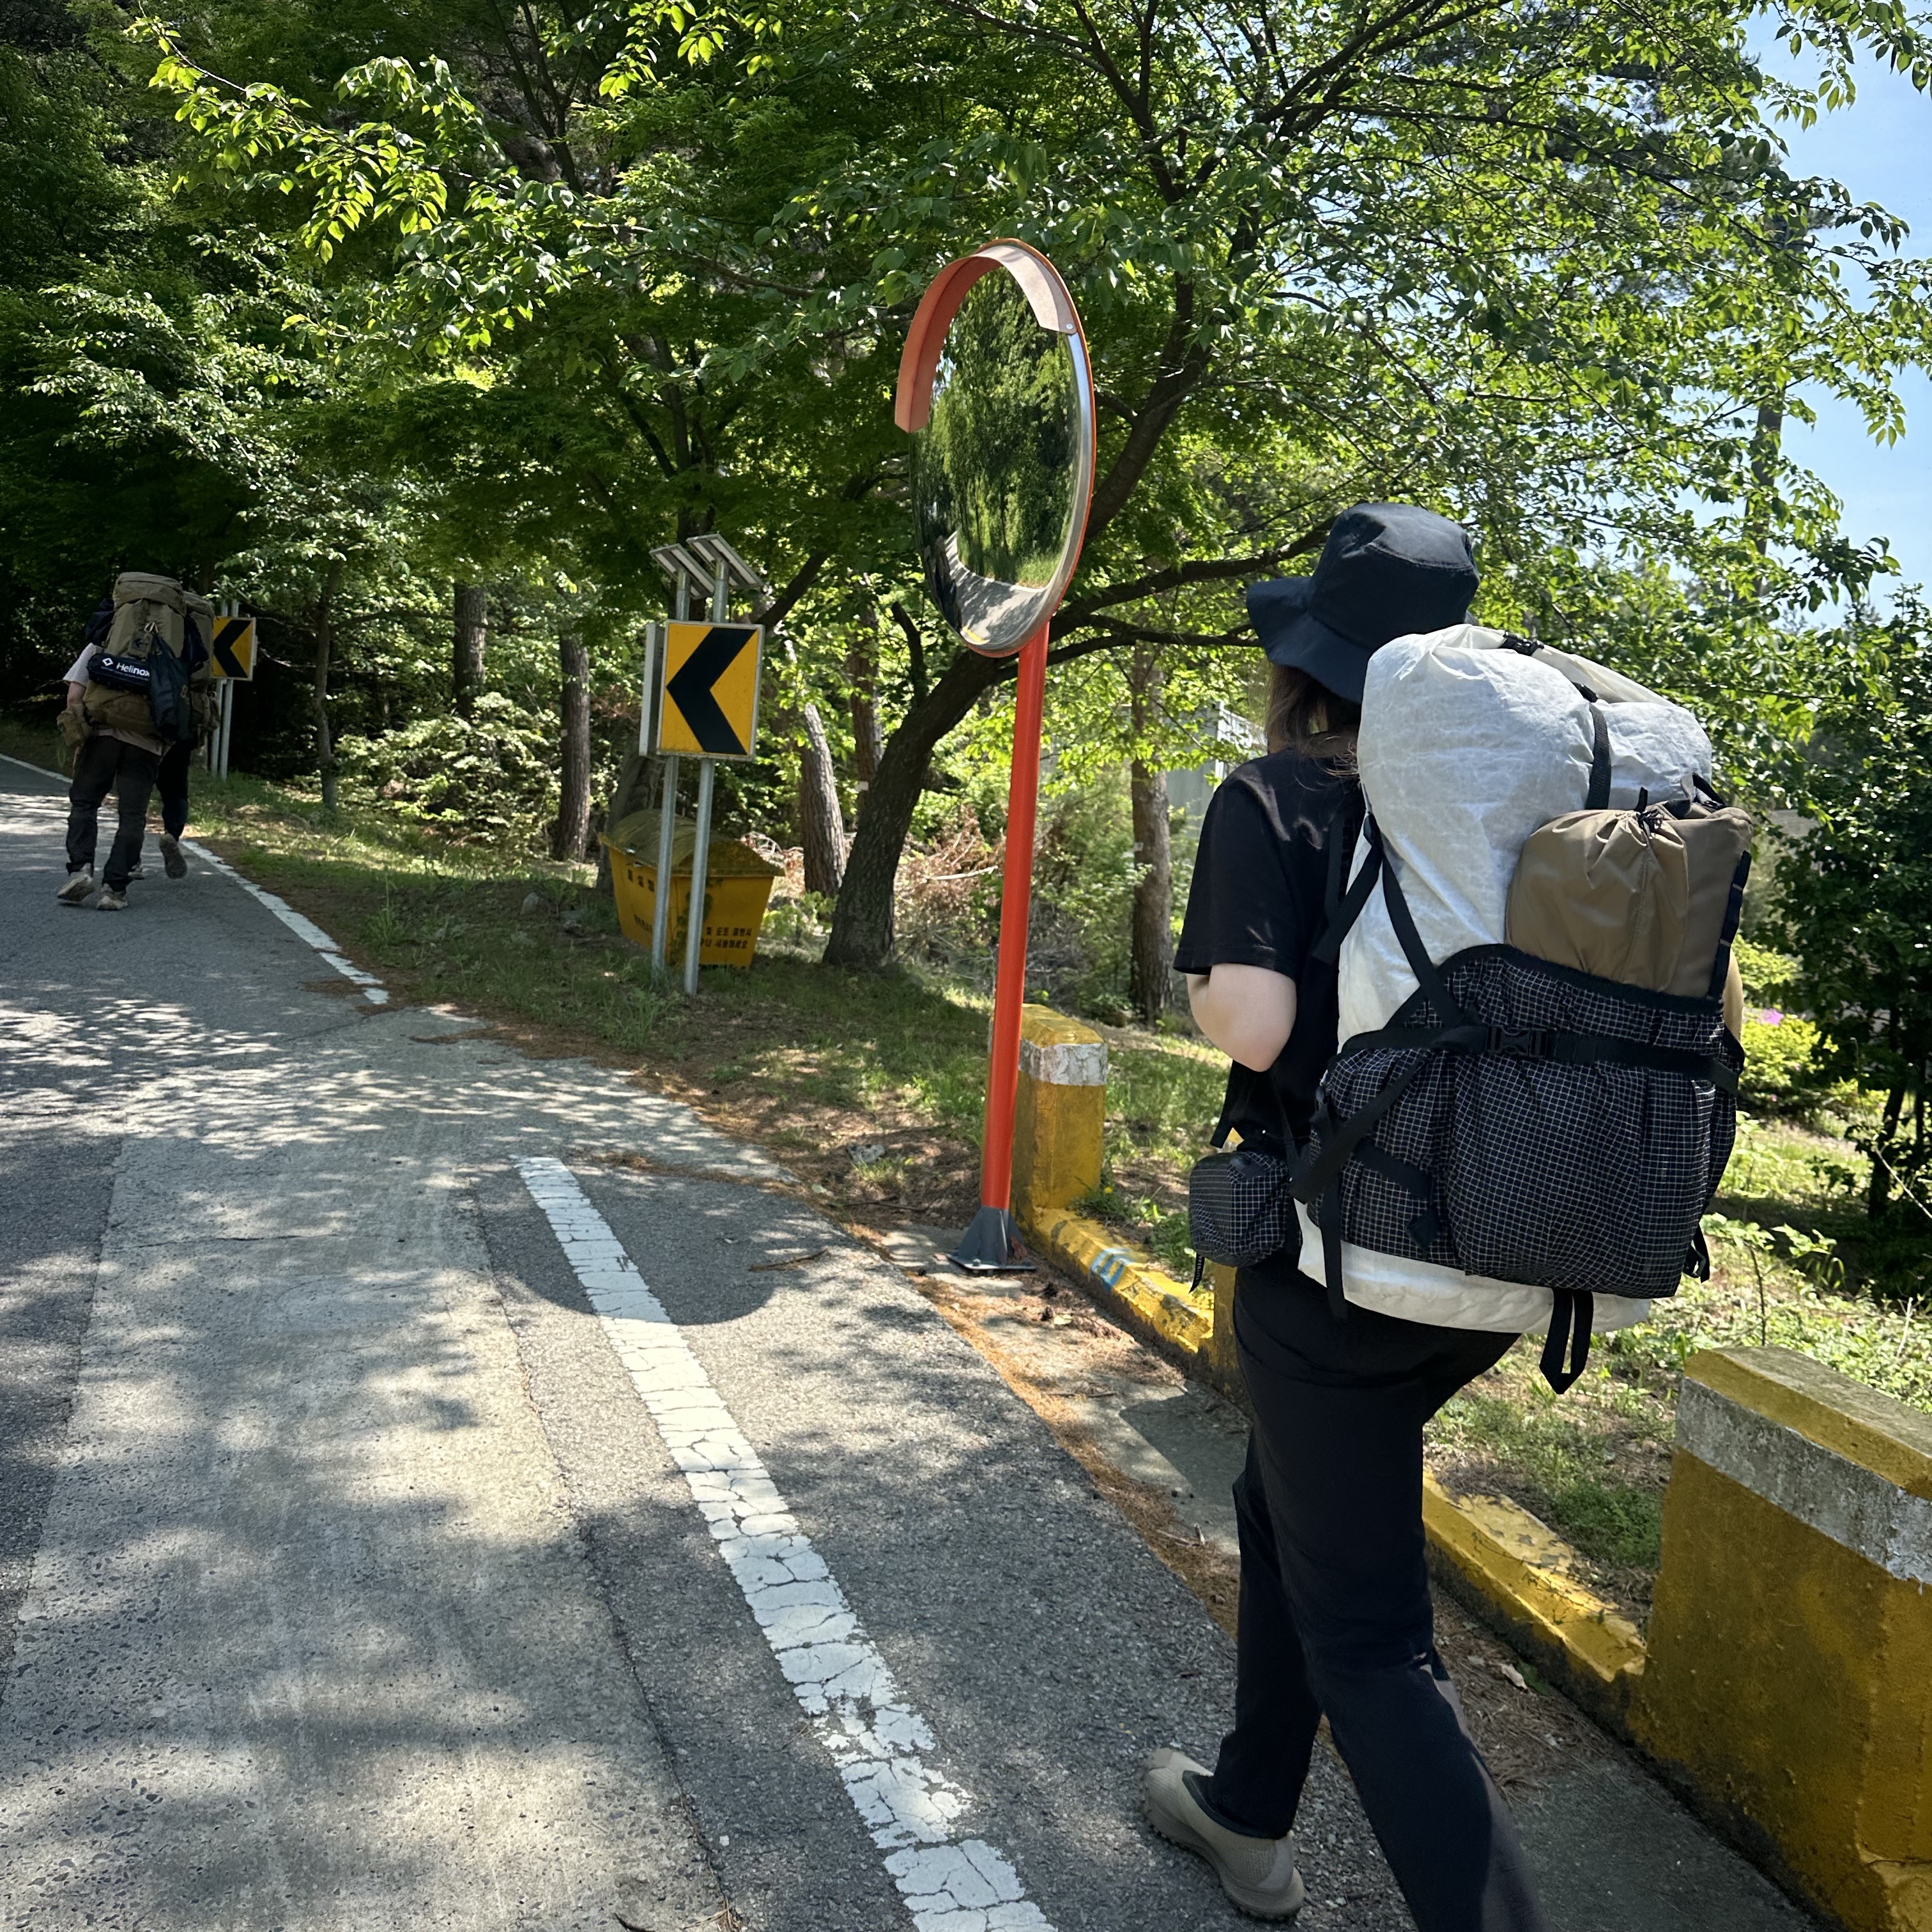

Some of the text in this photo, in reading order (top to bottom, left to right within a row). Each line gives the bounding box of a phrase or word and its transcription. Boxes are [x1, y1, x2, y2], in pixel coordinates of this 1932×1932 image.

[116, 663, 150, 677] Helinox
[716, 927, 729, 936] 도로
[715, 939, 748, 949] 사용하세요
